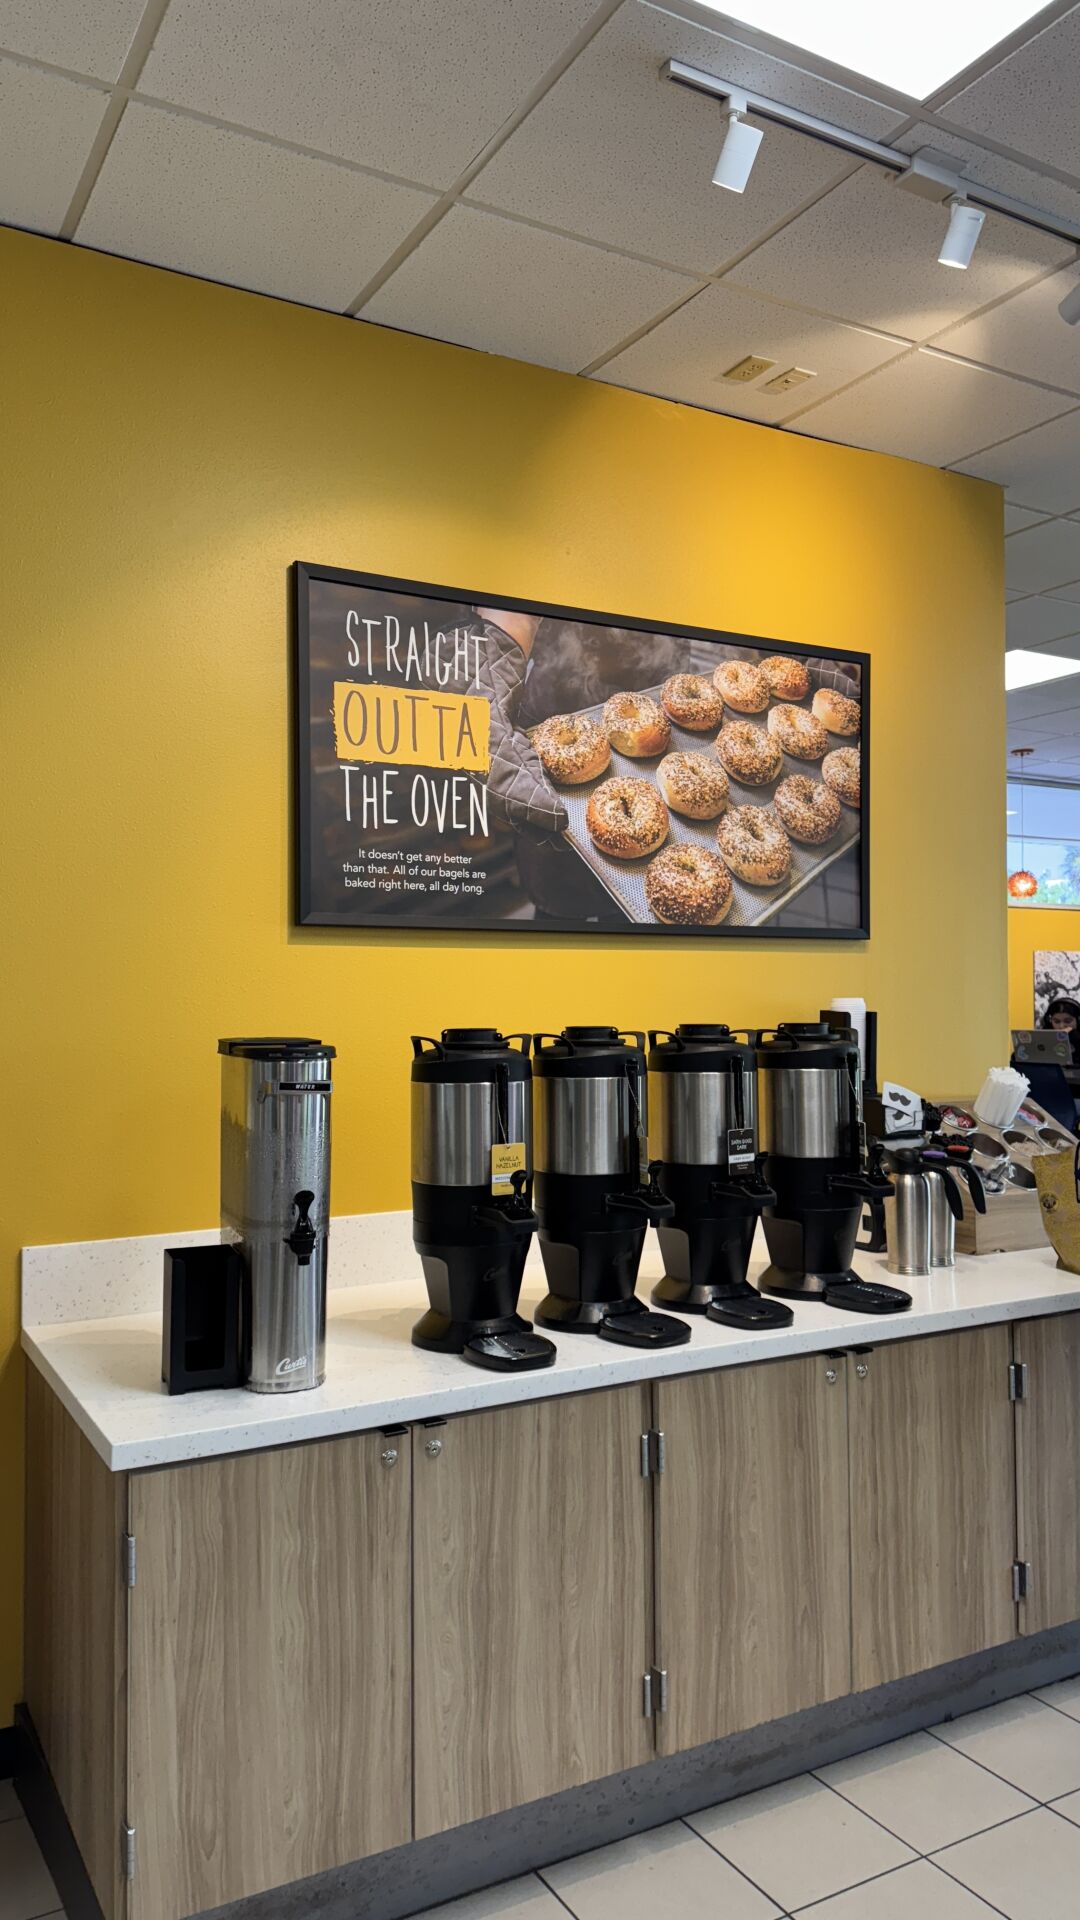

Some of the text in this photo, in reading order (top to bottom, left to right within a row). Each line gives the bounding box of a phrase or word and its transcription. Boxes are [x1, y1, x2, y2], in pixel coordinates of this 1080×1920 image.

[346, 610, 488, 689] STRAIGHT
[344, 690, 477, 761] OUTTA
[340, 765, 488, 837] THE OVEN
[342, 862, 486, 880] than that. All of our bagels are
[358, 848, 472, 865] It doesn't get any better
[344, 877, 485, 895] baked right here, all day long.
